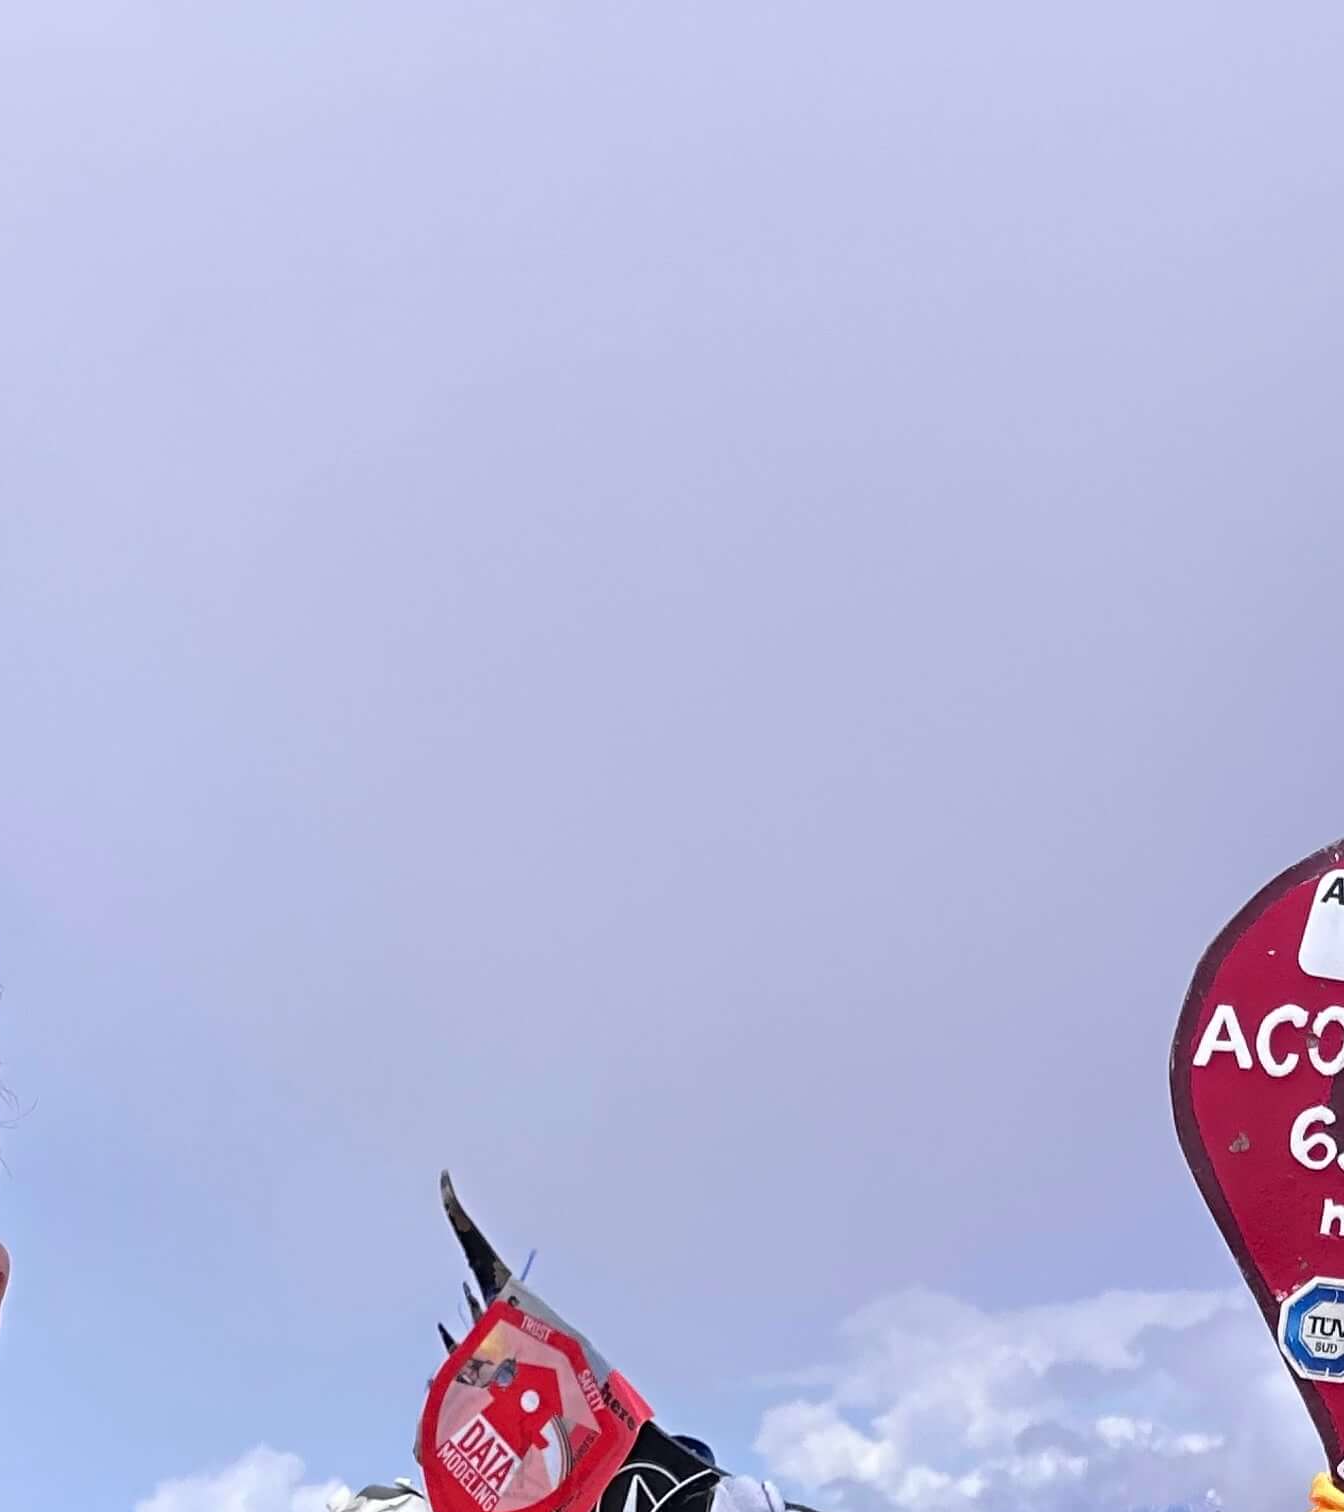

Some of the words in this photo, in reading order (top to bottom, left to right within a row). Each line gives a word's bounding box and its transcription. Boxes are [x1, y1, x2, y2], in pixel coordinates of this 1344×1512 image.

[520, 1314, 552, 1341] TRUST
[577, 1368, 607, 1412] SAFETY
[435, 1439, 500, 1512] MODELING
[457, 1422, 515, 1491] DATA
